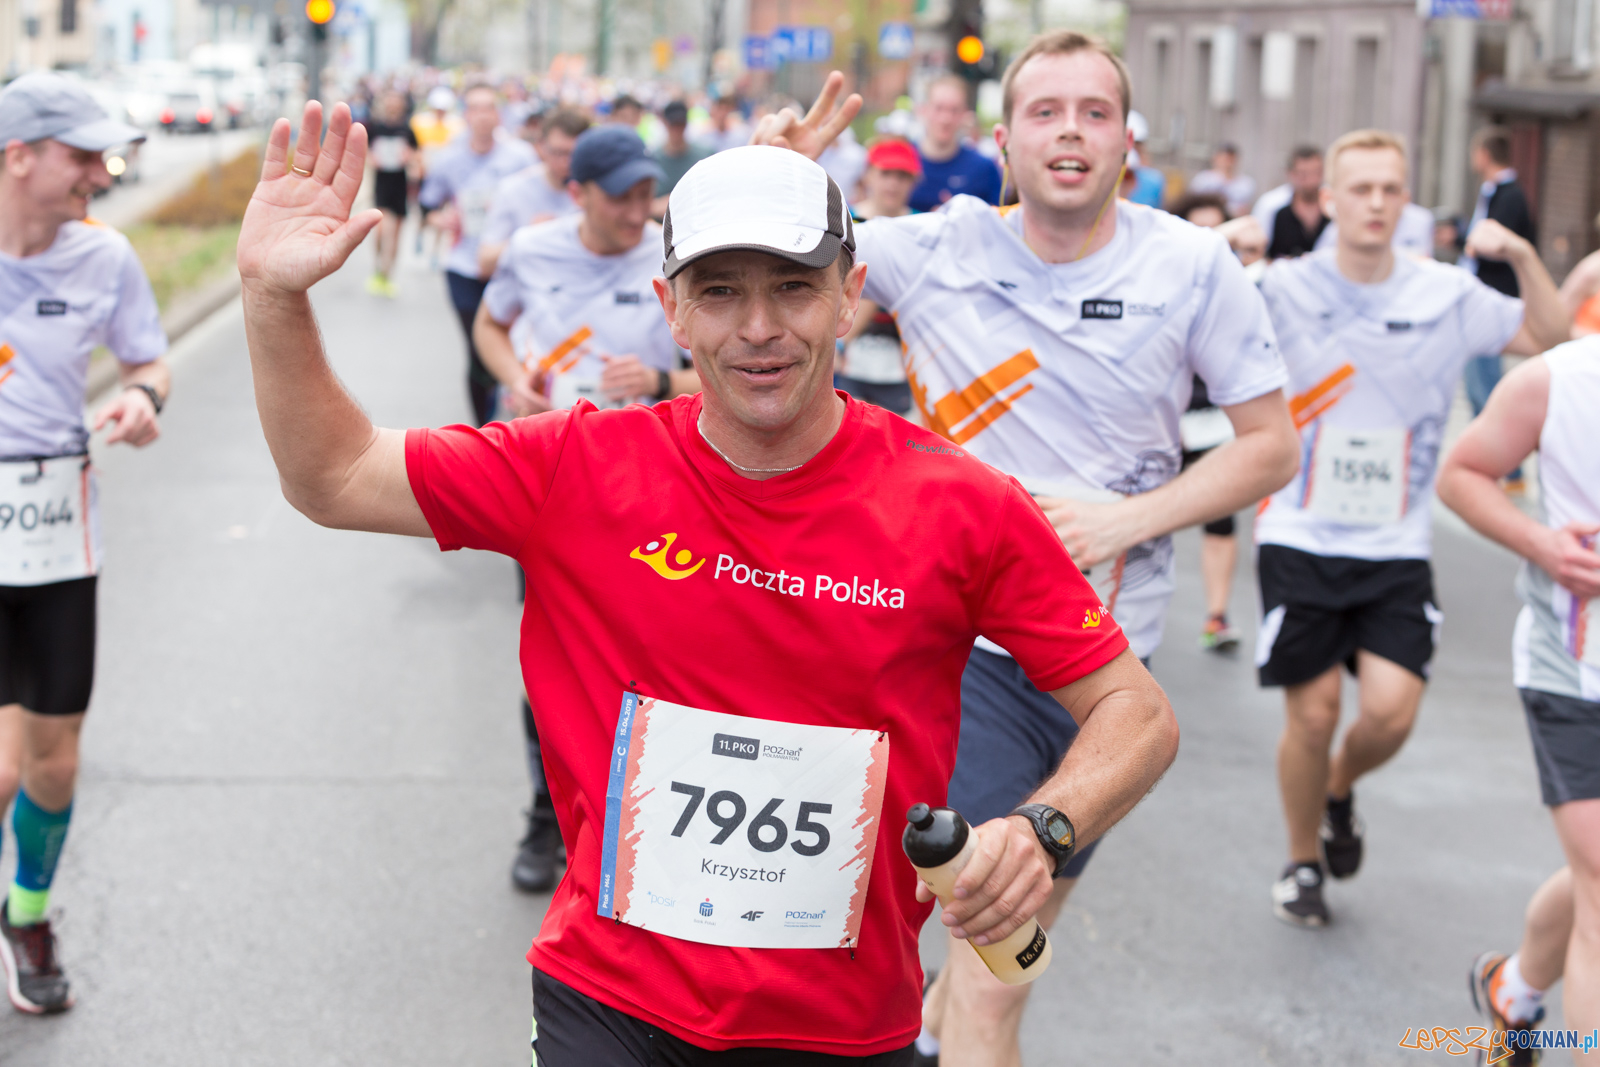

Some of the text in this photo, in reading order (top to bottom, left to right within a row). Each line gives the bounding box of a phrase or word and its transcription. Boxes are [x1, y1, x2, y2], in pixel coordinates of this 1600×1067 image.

[906, 439, 964, 457] newline
[1333, 458, 1391, 484] 1594
[0, 498, 72, 530] 9044
[714, 553, 905, 609] Poczta Polska
[620, 698, 633, 736] 15.04.2018
[617, 746, 626, 756] C
[732, 742, 755, 755] PKO
[670, 780, 832, 857] 7965
[701, 858, 786, 883] Krzysztof
[741, 910, 764, 921] 4F
